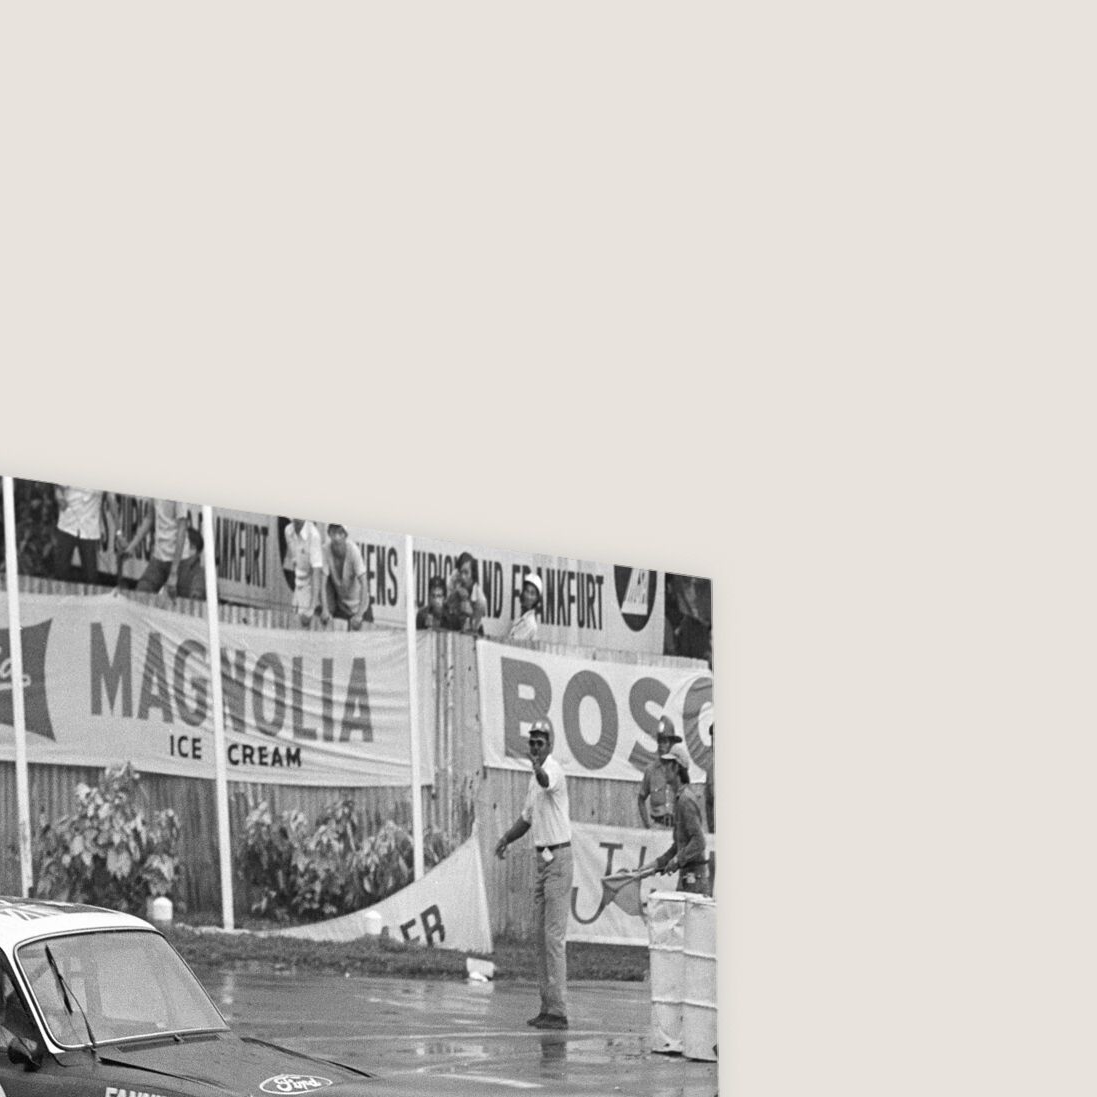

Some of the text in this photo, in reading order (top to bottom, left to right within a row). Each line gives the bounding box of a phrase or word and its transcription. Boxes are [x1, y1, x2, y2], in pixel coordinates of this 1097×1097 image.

[90, 621, 374, 743] MAGNOLIA
[169, 734, 302, 768] ICE CREAM
[273, 1075, 323, 1092] Ford
